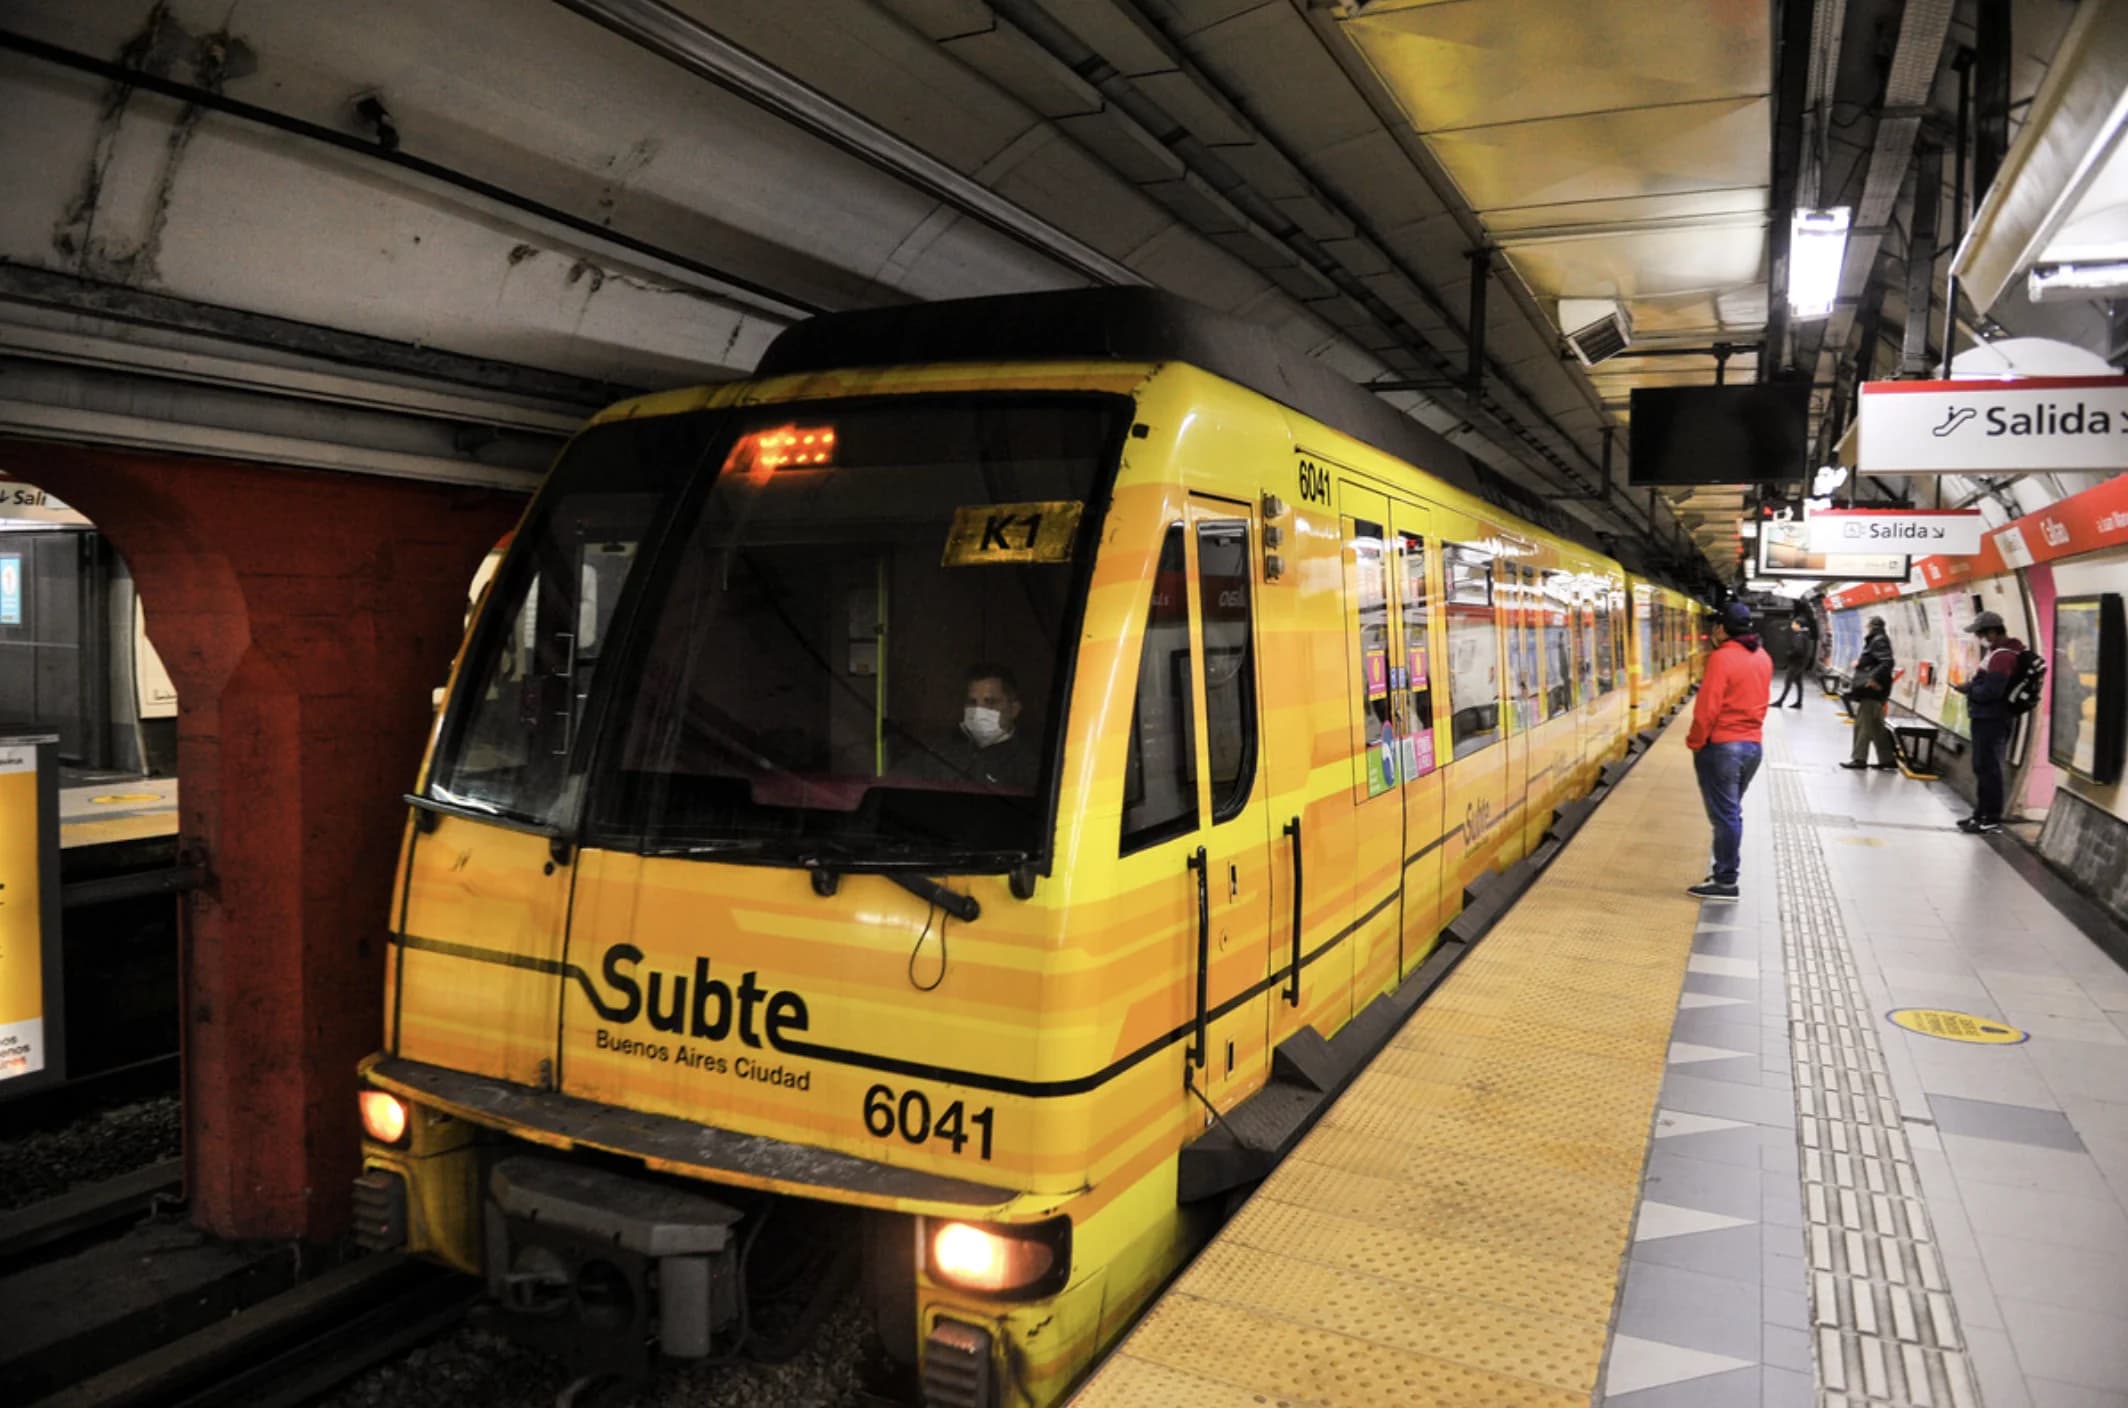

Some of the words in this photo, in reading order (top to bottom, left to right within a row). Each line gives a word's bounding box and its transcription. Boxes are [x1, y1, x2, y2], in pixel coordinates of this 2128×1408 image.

[1986, 402, 2110, 436] Salida
[1299, 459, 1331, 507] 6041
[1869, 522, 1929, 540] Salida
[602, 942, 810, 1054] Subte
[596, 1029, 669, 1062] Buenos
[674, 1045, 728, 1074] Aires
[734, 1056, 811, 1092] Ciudad
[863, 1083, 994, 1161] 6041
